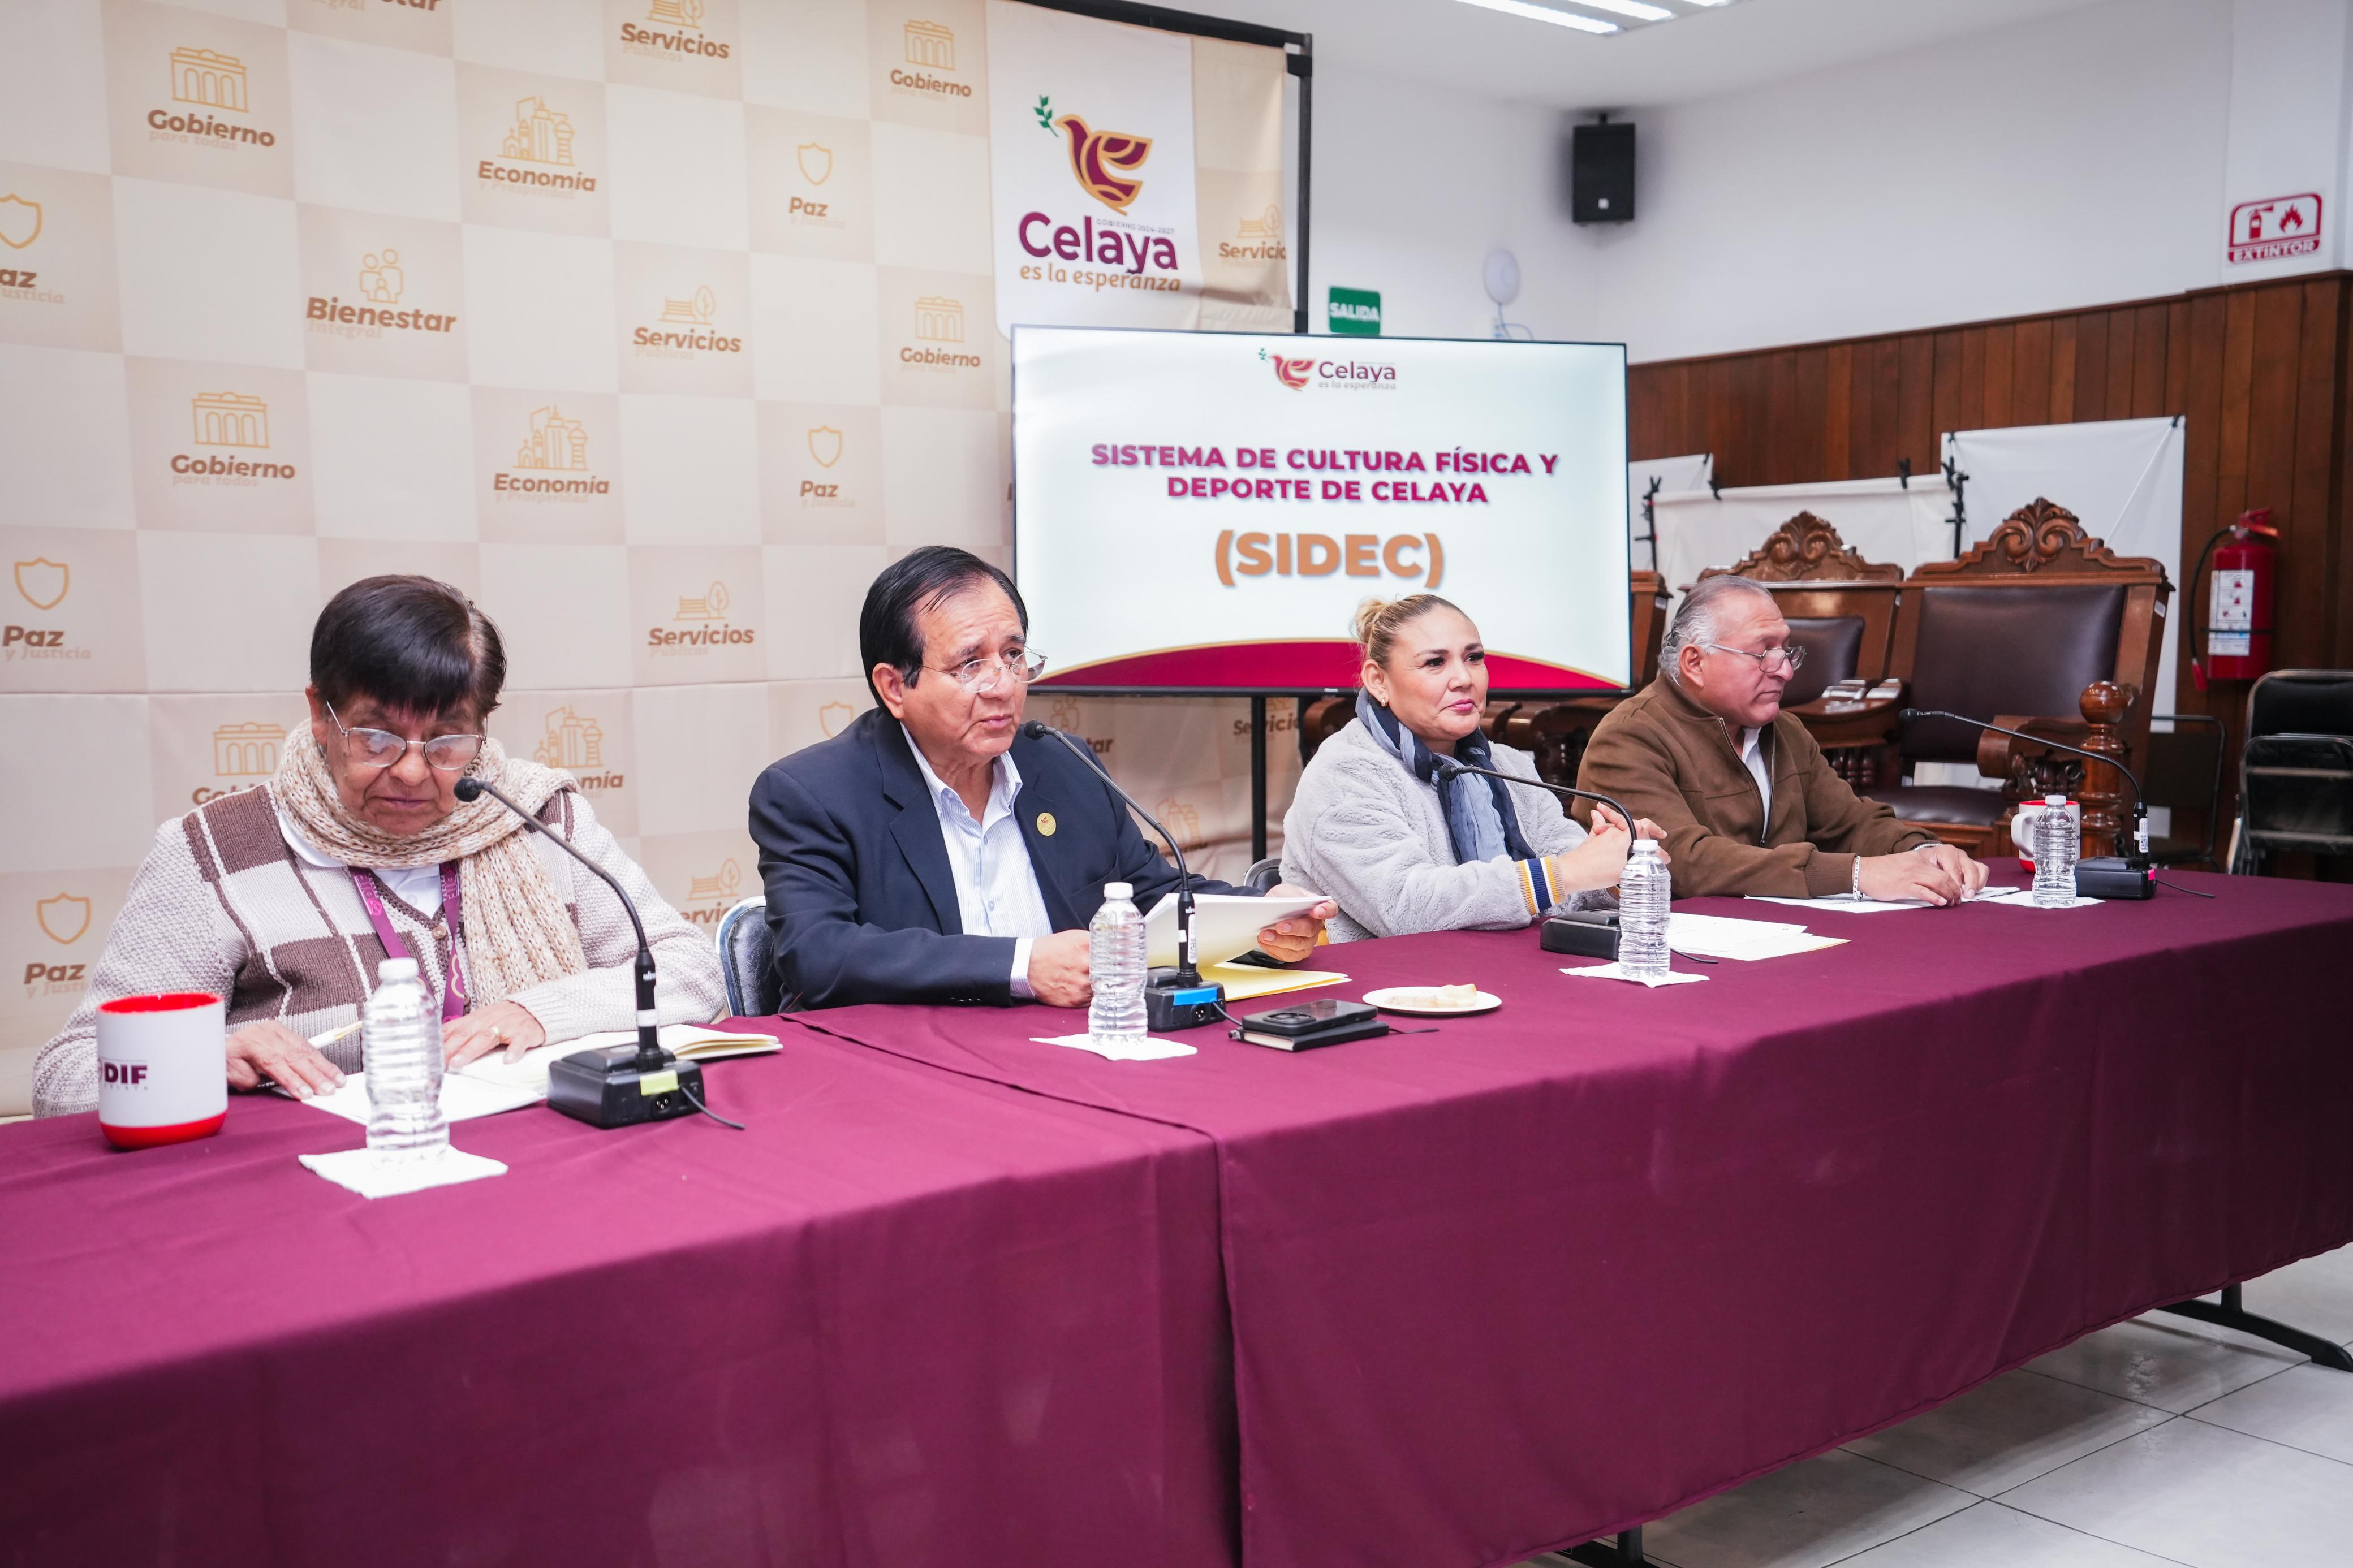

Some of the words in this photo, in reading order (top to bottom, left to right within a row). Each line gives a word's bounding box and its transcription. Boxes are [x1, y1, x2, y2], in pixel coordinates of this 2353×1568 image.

[620, 23, 730, 58] Servicios
[891, 69, 971, 97] Gobierno
[148, 110, 275, 146] Gobierno
[478, 161, 596, 191] Economía
[789, 196, 828, 217] Paz
[1096, 219, 1135, 230] GOBIERNO
[1019, 211, 1178, 274] Celaya
[2233, 241, 2315, 261] EXTINTOR
[0, 269, 37, 288] az
[1020, 265, 1041, 280] es
[1048, 263, 1067, 282] la
[1072, 269, 1181, 292] esperanza
[307, 297, 456, 332] Bienestar
[1329, 302, 1380, 322] SALIDA
[634, 327, 741, 352] Servicios
[900, 347, 980, 367] Gobierno
[1318, 360, 1395, 382] Celaya
[1344, 382, 1396, 391] esperanza
[171, 455, 295, 478] Gobierno
[1092, 443, 1226, 467] SISTEMA
[1236, 447, 1276, 468] DE
[1287, 448, 1425, 471] CULTURA
[1436, 446, 1531, 473] FÍSICA
[1539, 454, 1558, 474] Y
[494, 473, 609, 494] Economía
[800, 480, 838, 497] Paz
[1168, 477, 1311, 499] DEPORTE
[1321, 480, 1361, 500] DE
[1372, 481, 1488, 502] CELAYA
[1216, 529, 1444, 589] (SIDEC)
[3, 626, 64, 647] Paz
[648, 624, 754, 645] Servicios
[24, 962, 85, 984] Paz
[104, 1062, 148, 1084] DIF
